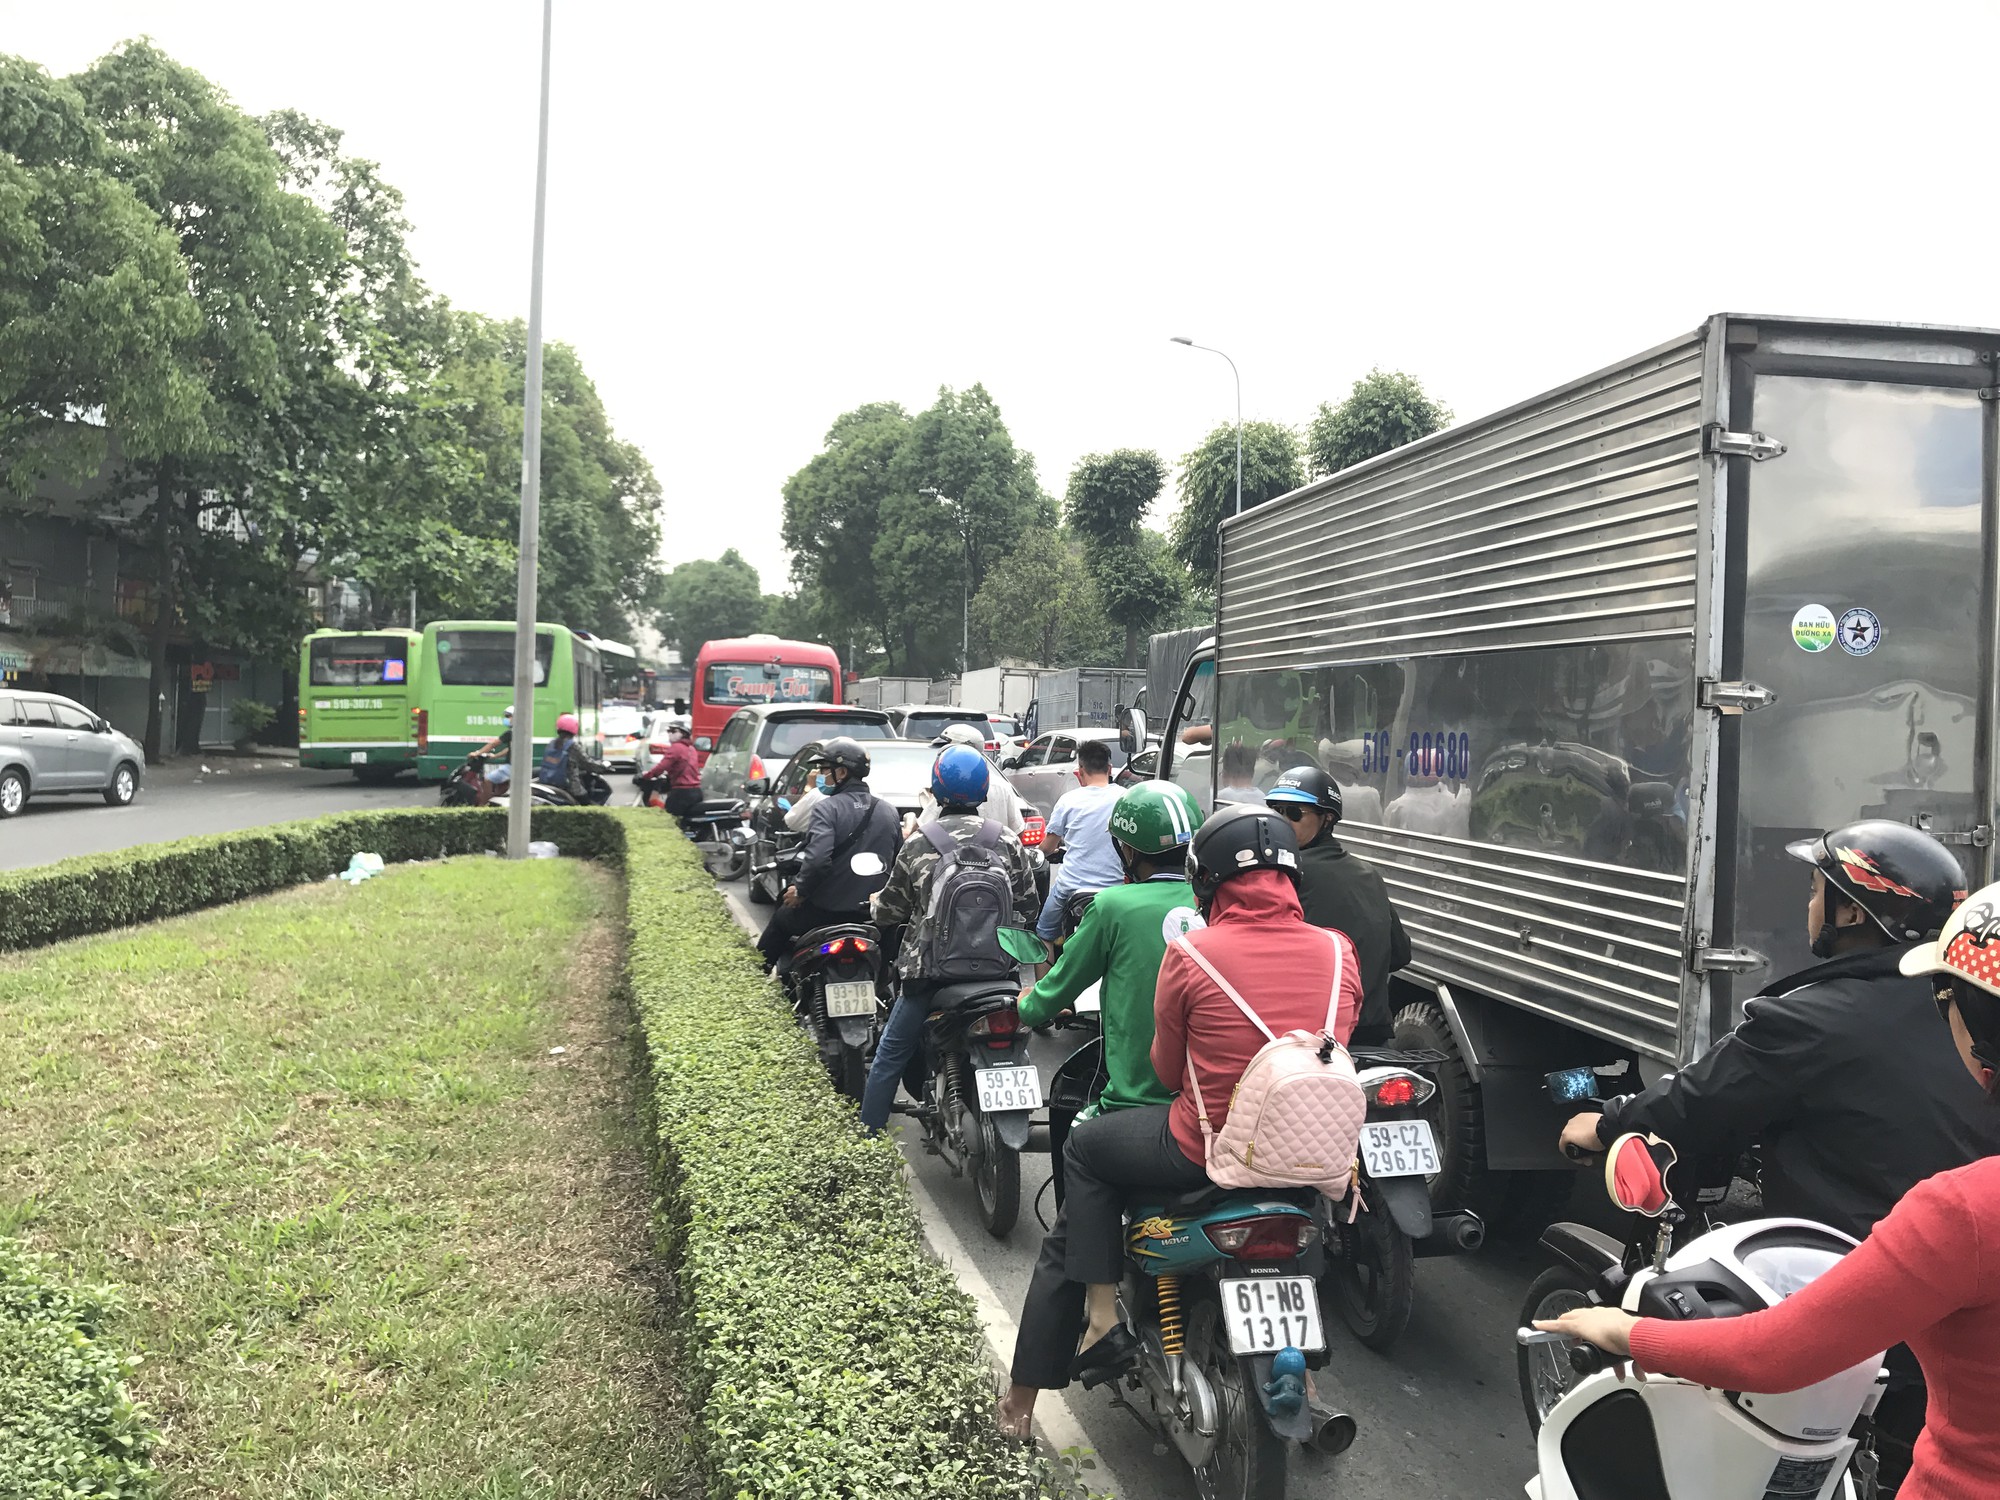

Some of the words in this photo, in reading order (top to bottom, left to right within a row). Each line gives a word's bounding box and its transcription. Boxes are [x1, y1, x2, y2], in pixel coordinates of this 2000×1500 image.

[810, 669, 829, 680] Linh
[1362, 730, 1390, 774] 51C
[1409, 731, 1469, 780] 80680
[1112, 812, 1138, 834] Grab
[834, 998, 870, 1014] 6878
[985, 1070, 1030, 1089] 59-X2
[983, 1088, 1036, 1109] 849.61
[1368, 1125, 1423, 1148] 59-C2
[1368, 1147, 1435, 1174] 296.75
[1236, 1281, 1306, 1314] 61-N8
[1243, 1315, 1308, 1349] 1317
